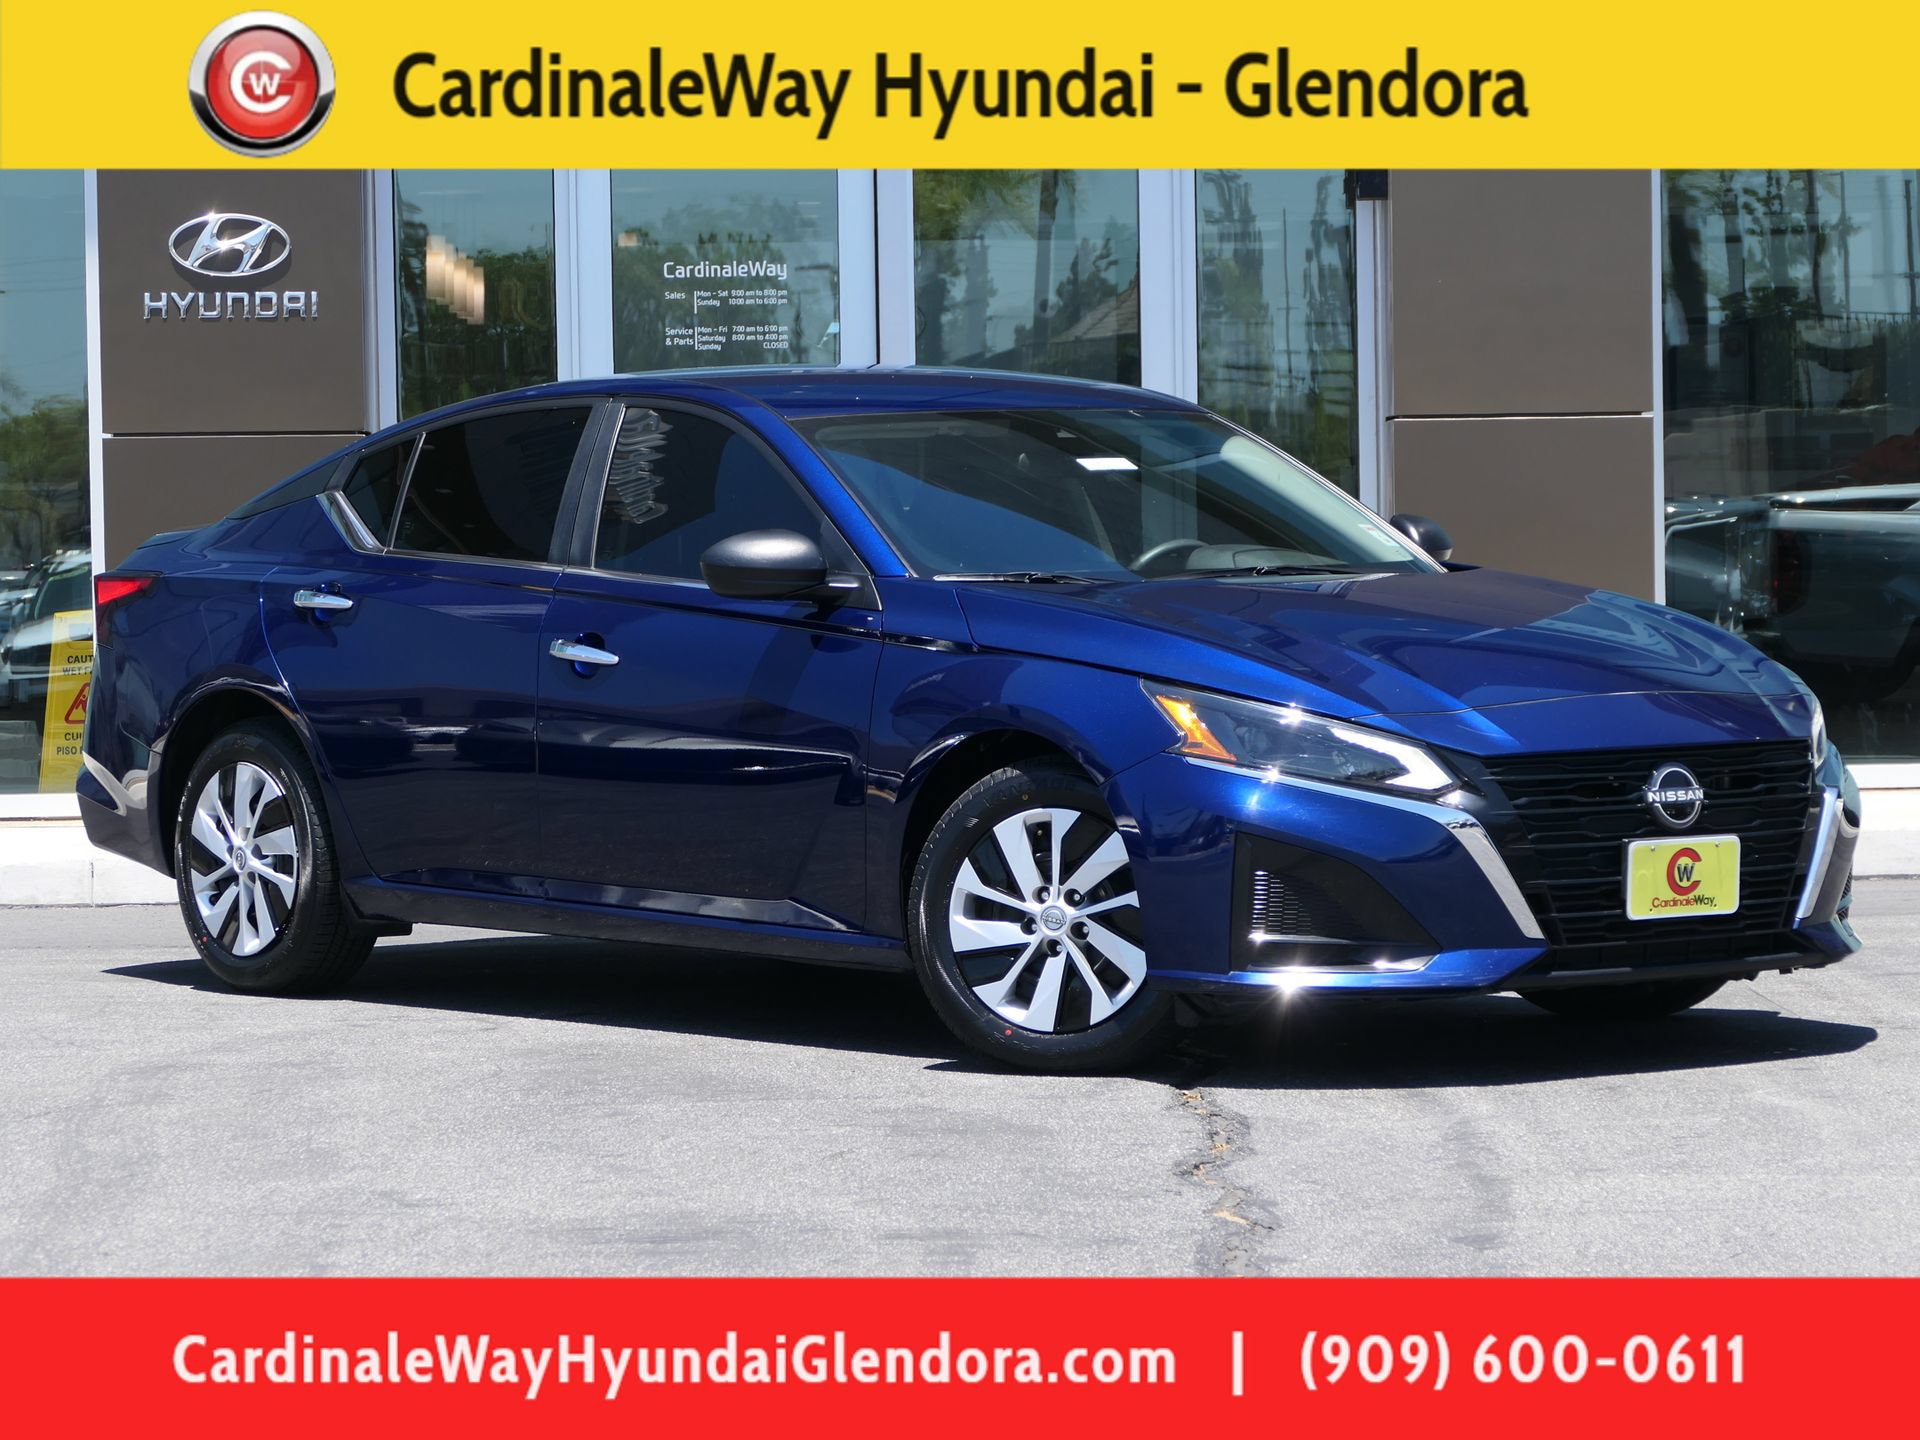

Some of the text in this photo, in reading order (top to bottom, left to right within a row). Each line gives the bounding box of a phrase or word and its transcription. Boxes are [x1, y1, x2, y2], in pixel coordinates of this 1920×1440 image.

[664, 260, 787, 280] CardinaleWay
[665, 291, 685, 300] Sales
[144, 291, 318, 319] HYUNDAI
[697, 299, 720, 307] Sunday
[665, 327, 693, 336] Service
[674, 337, 694, 346] Parts
[698, 334, 725, 342] Saturday
[698, 343, 721, 351] Sunday
[62, 667, 81, 676] WET
[56, 746, 78, 755] PISO
[1648, 789, 1704, 803] NISSAN
